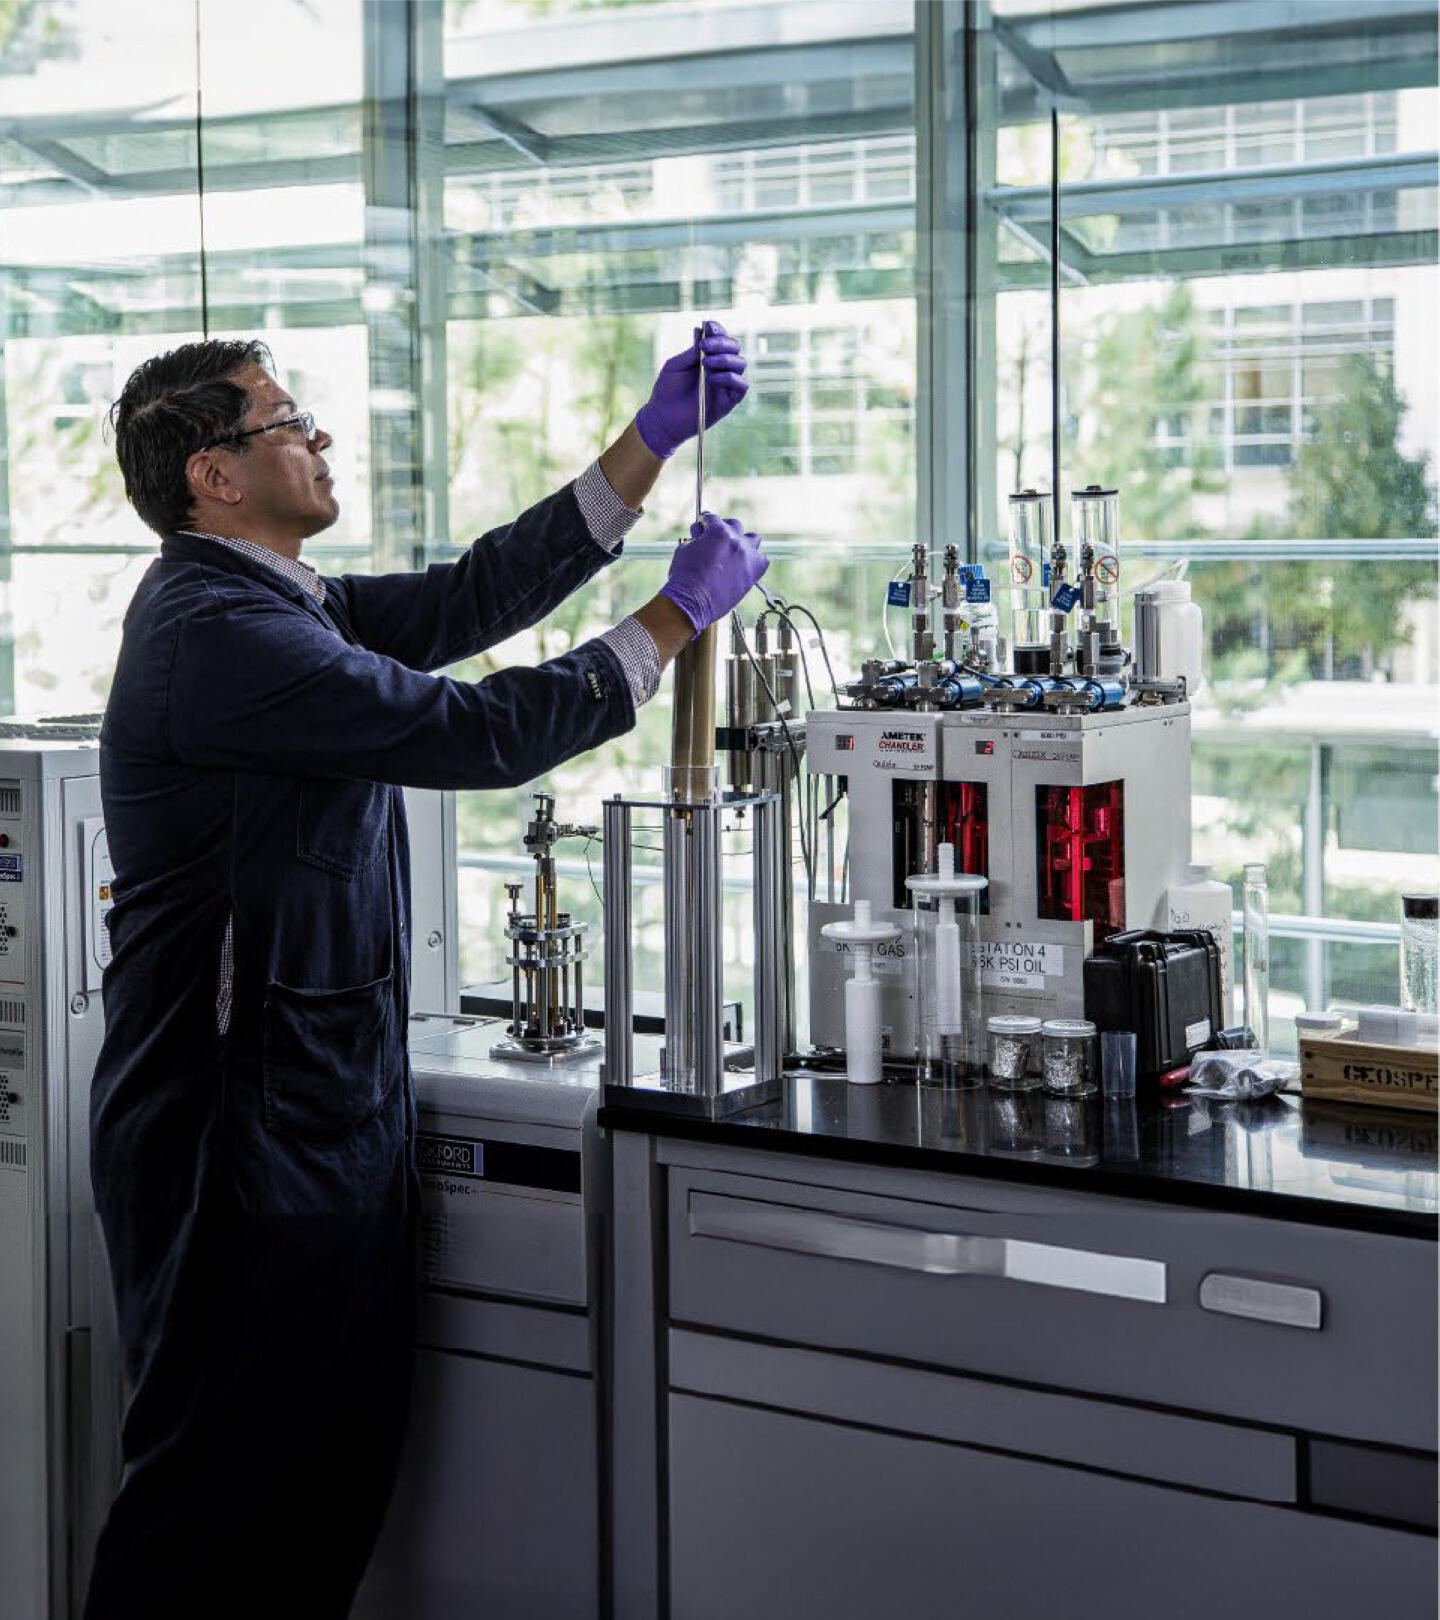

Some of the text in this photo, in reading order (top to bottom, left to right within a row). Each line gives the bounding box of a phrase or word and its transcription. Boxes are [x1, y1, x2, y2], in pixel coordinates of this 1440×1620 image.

[881, 731, 925, 741] AMETEK
[878, 740, 924, 752] CHANDLER
[877, 942, 905, 957] GAS
[1037, 944, 1046, 957] 4
[999, 956, 1019, 971] PSI
[1023, 959, 1046, 974] OIL
[423, 1142, 471, 1163] XFORD
